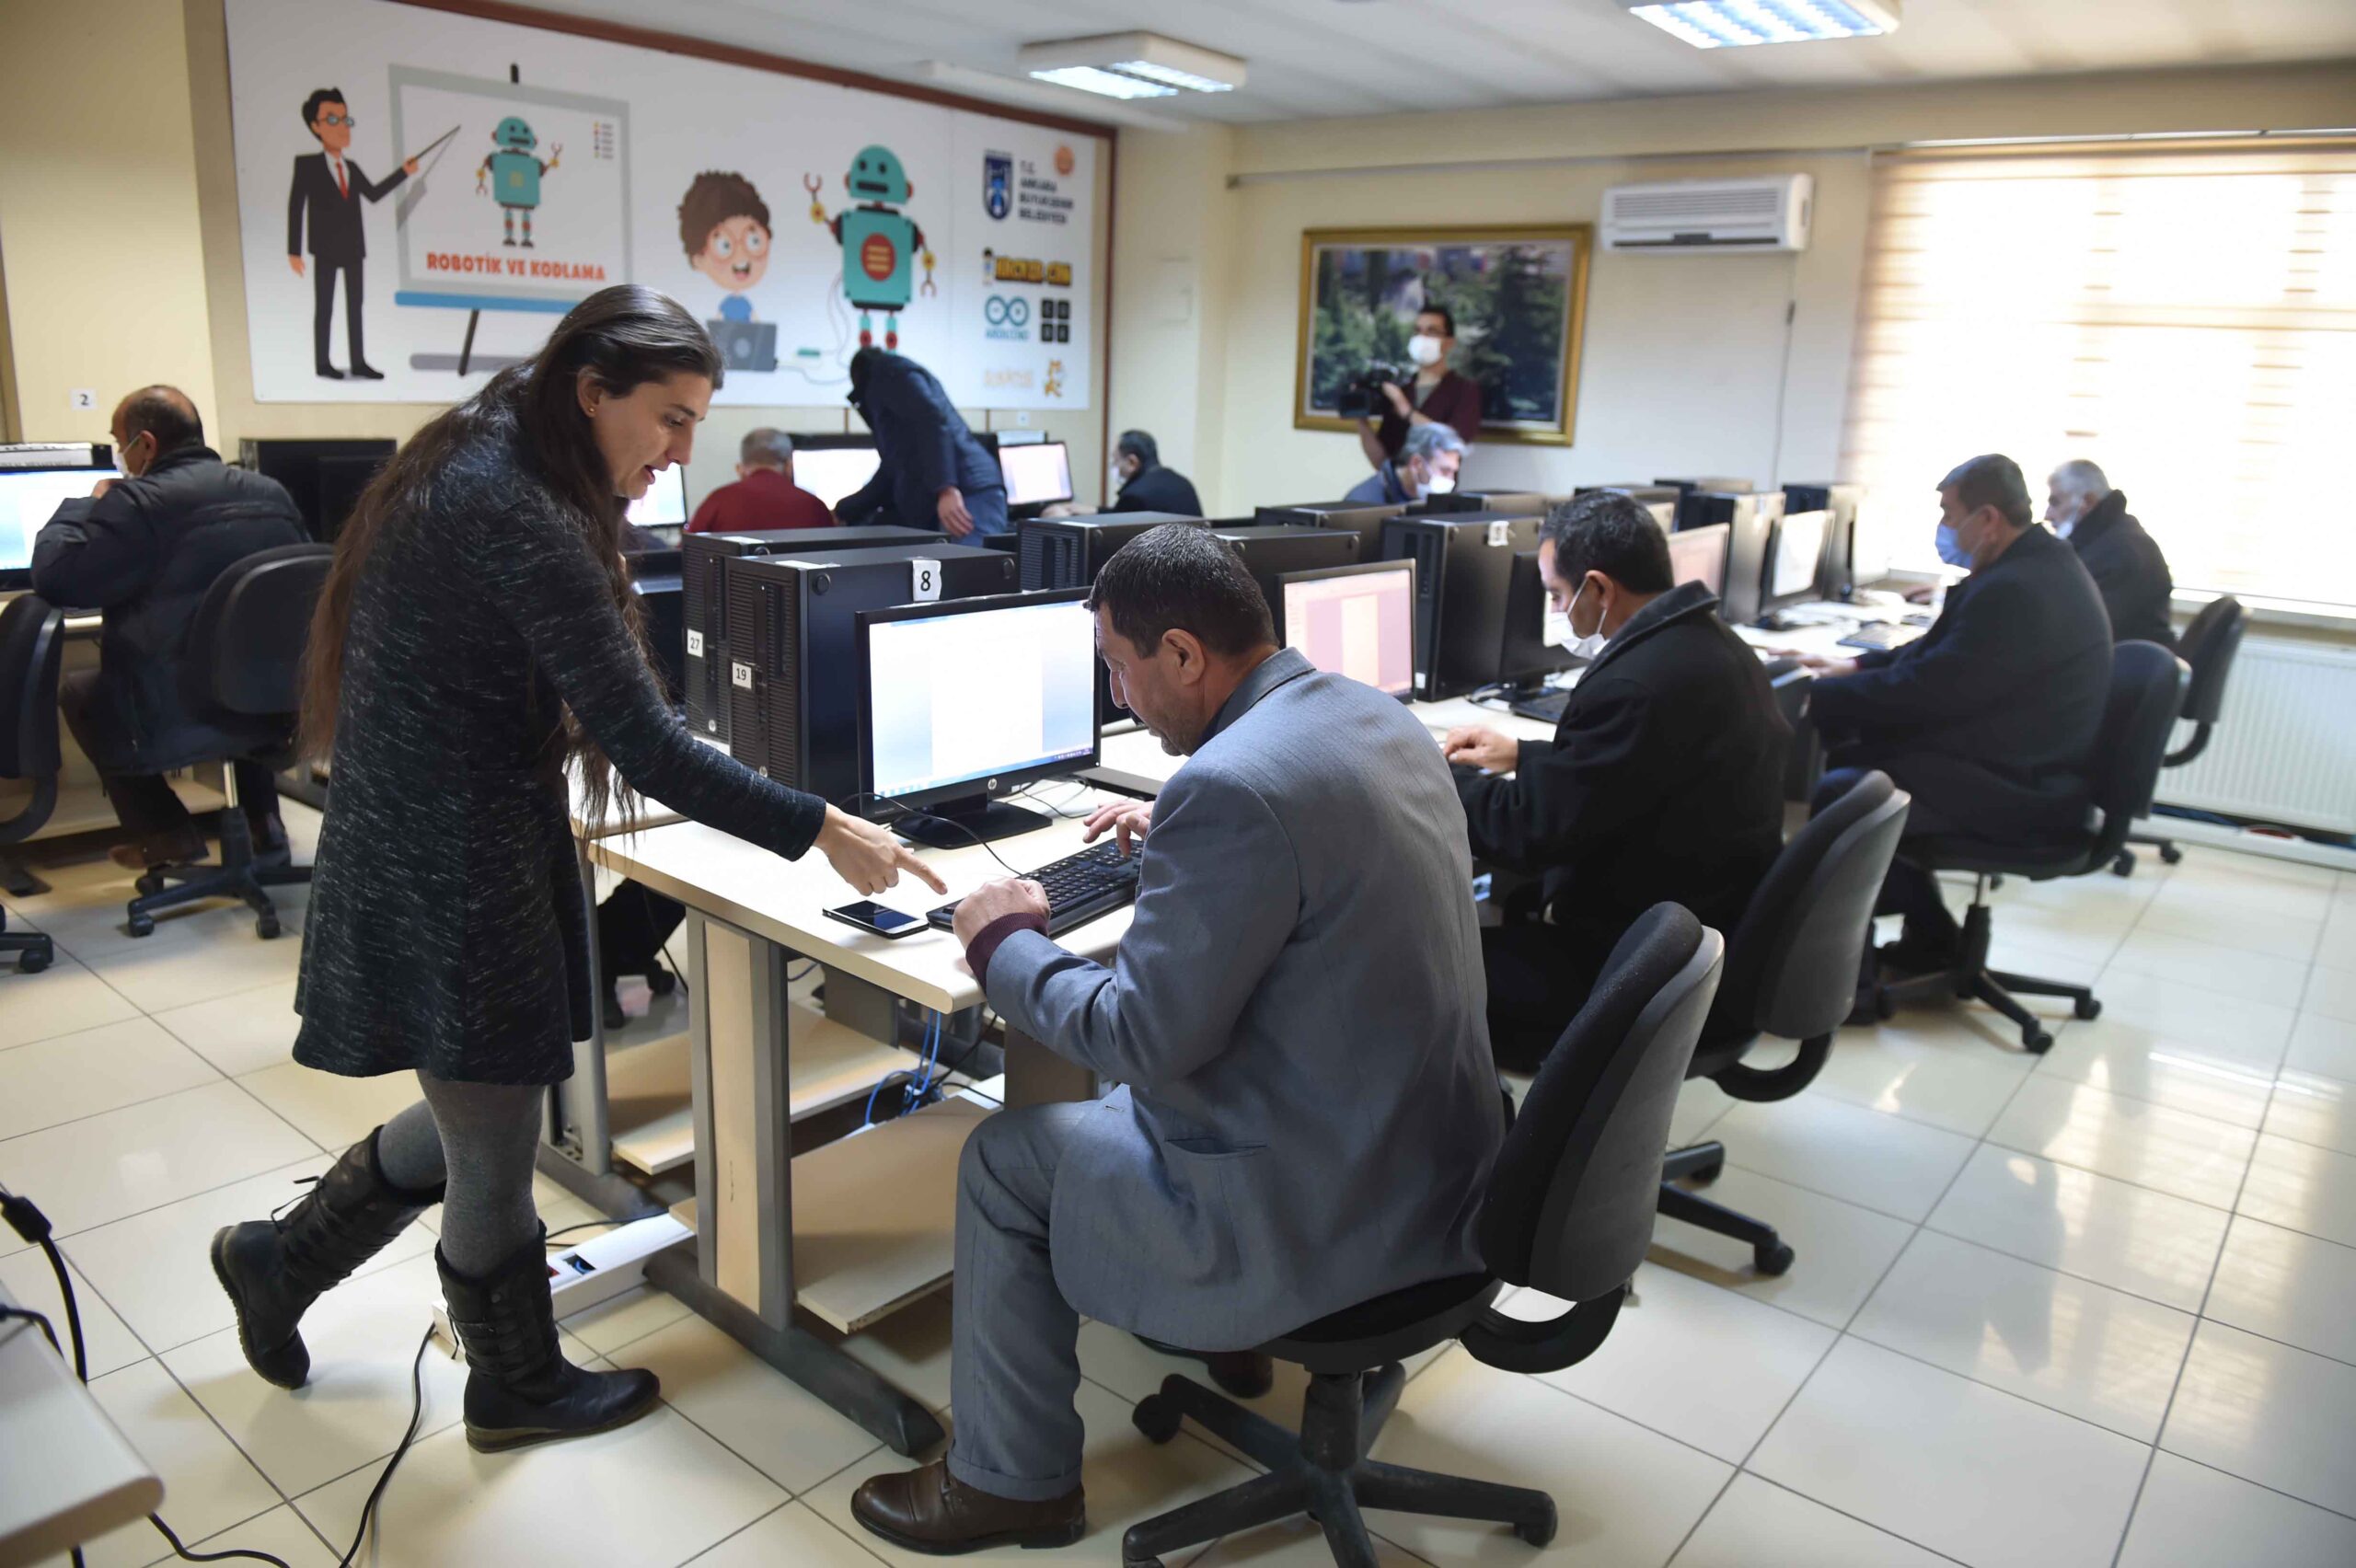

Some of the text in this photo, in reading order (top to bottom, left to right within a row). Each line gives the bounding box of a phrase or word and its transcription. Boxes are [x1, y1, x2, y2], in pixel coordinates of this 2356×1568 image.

[427, 251, 606, 281] ROBOTİK VE KODLAMA
[80, 394, 89, 406] 2
[920, 570, 930, 592] 8
[690, 637, 700, 650] 27
[736, 668, 746, 680] 19
